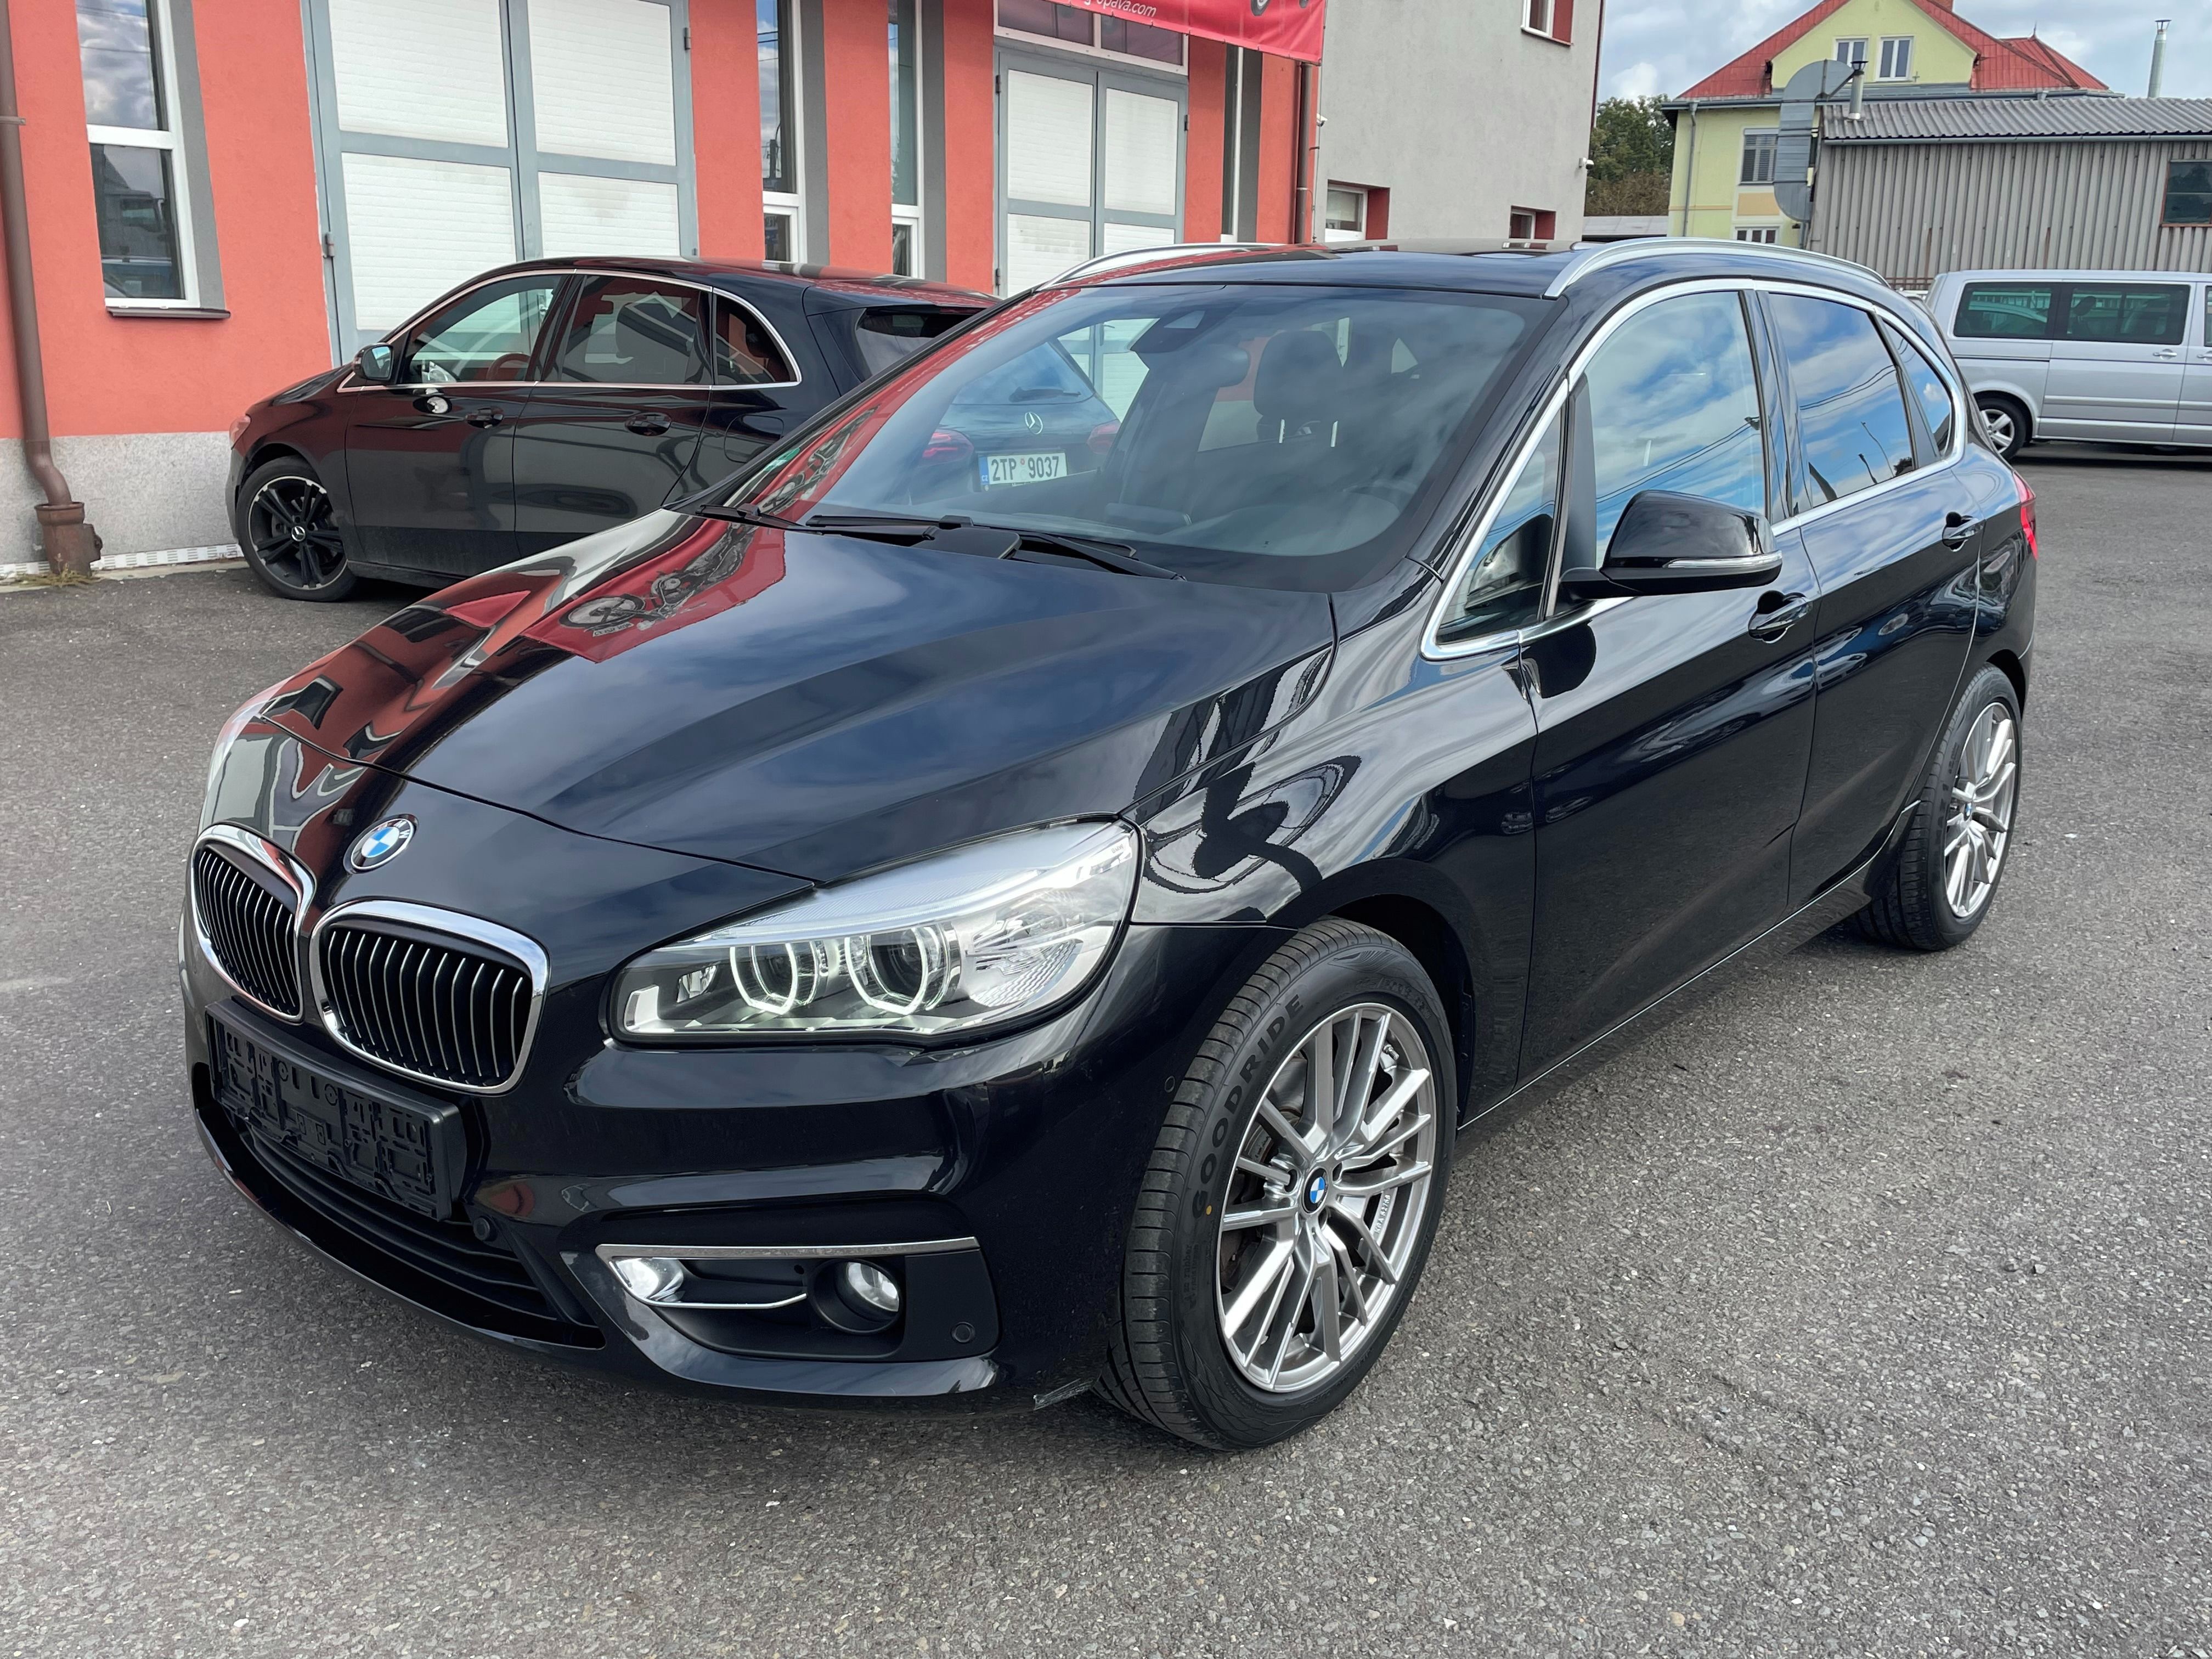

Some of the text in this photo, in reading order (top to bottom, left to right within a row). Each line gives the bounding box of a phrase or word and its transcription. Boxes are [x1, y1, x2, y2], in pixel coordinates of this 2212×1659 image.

[991, 456, 1059, 482] 2TP 9037
[1192, 994, 1304, 1219] GOODRIDE
